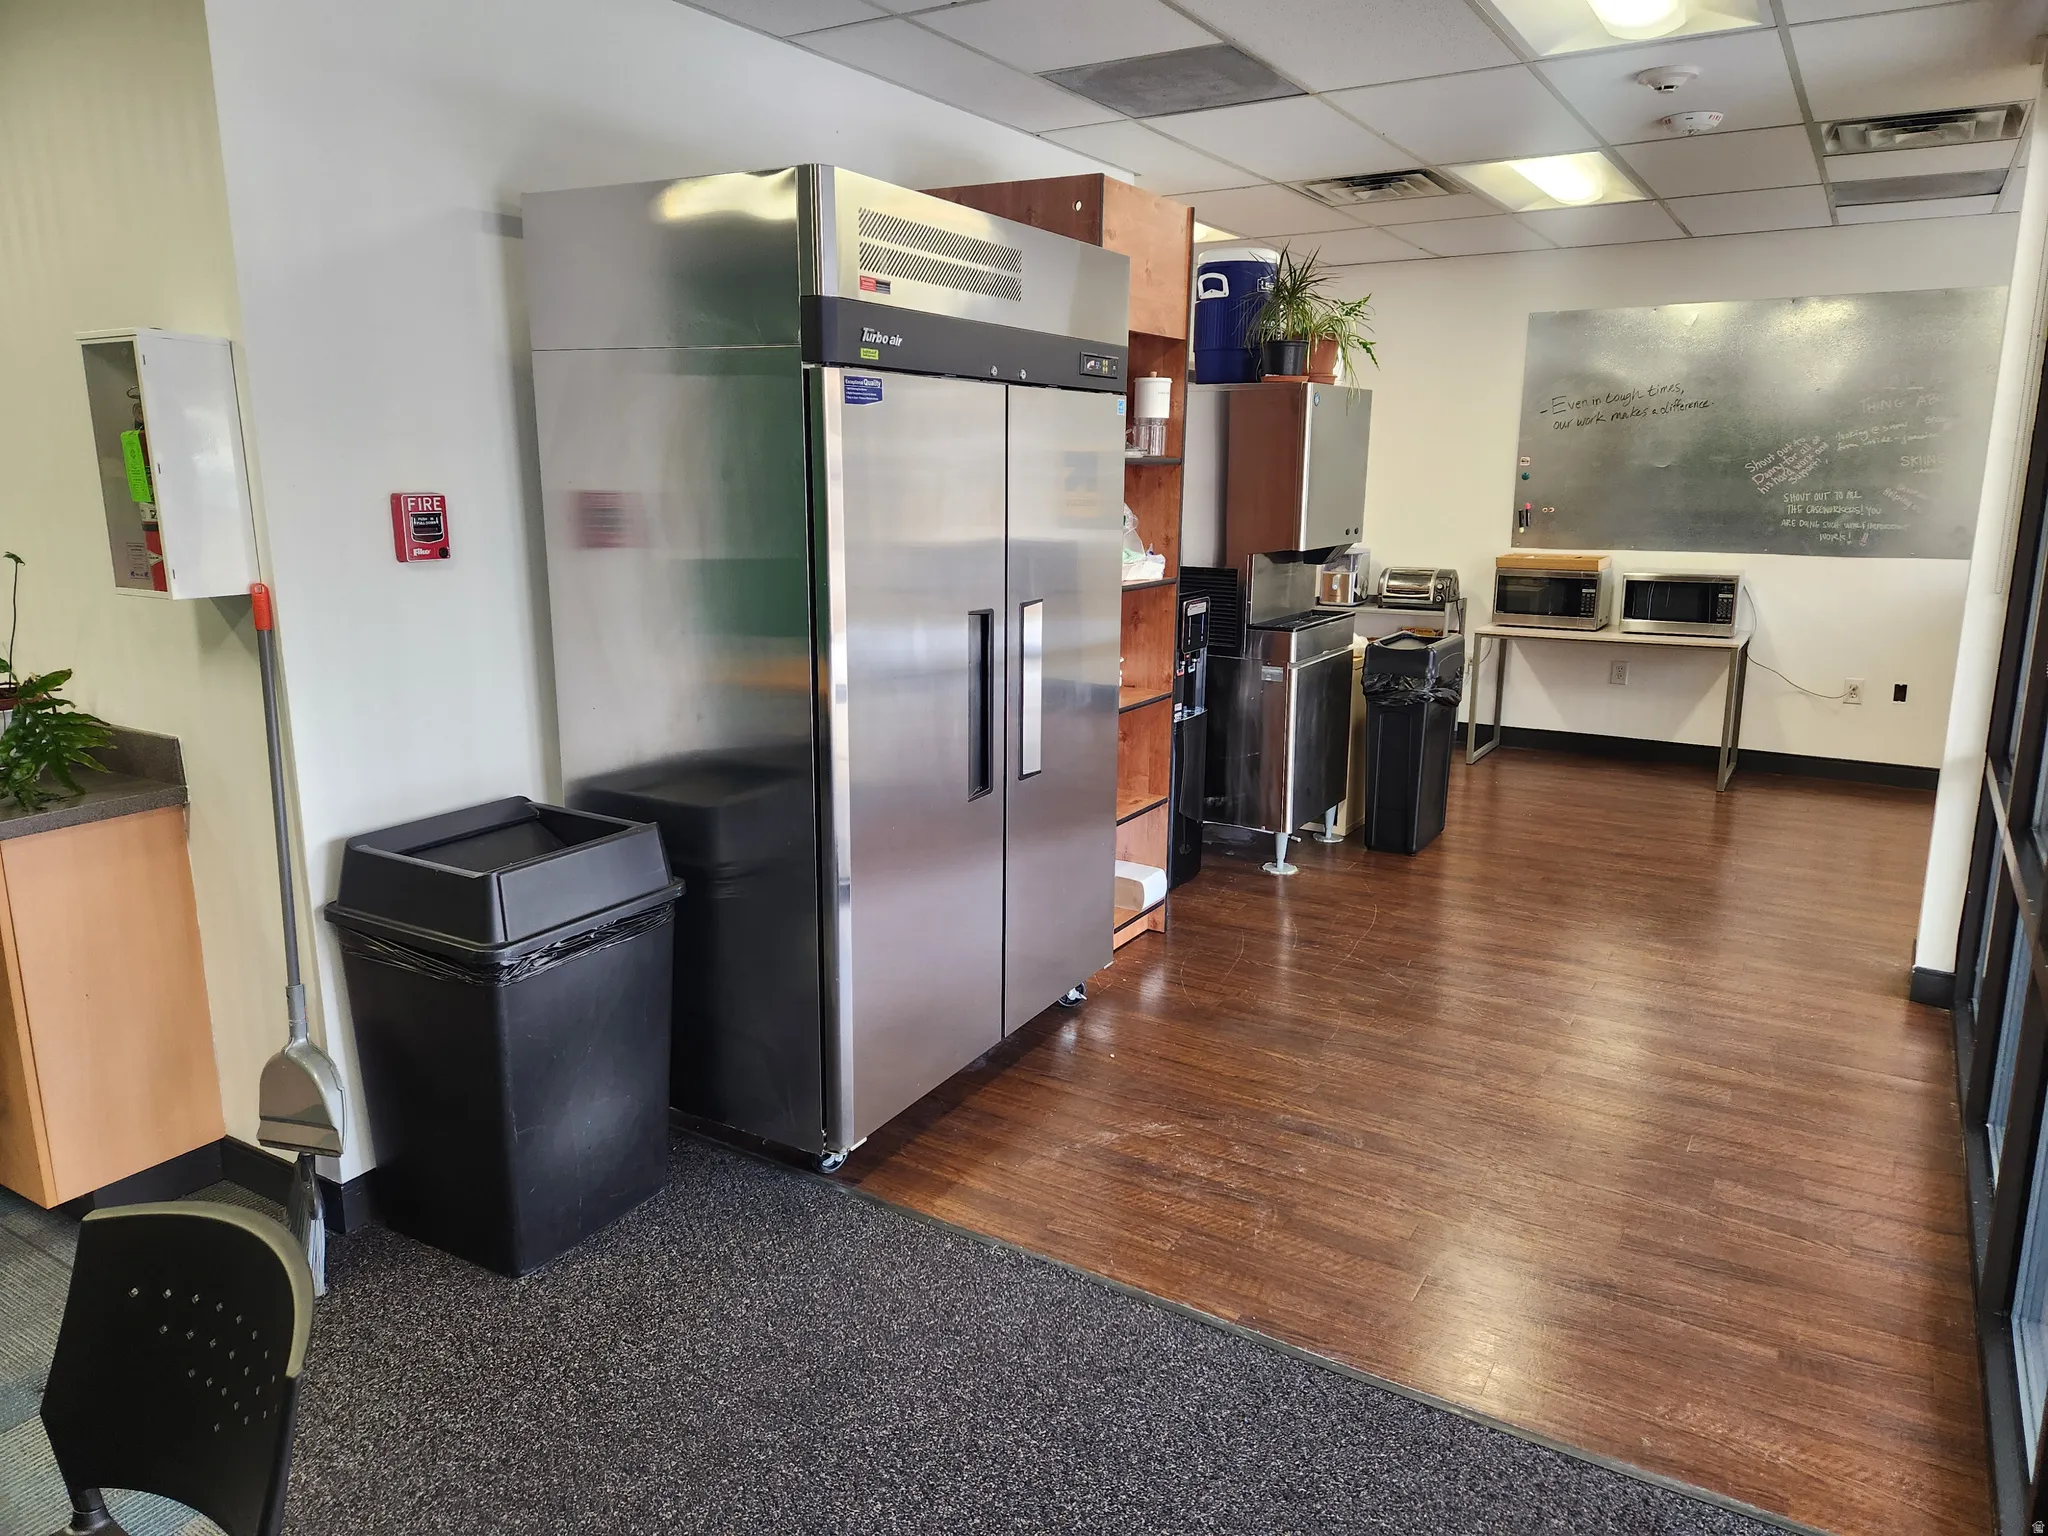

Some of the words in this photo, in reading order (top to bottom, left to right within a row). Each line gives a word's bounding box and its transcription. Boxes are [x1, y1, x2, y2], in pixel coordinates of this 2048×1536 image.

[862, 327, 888, 344] Turbo
[889, 335, 903, 346] air
[864, 379, 881, 388] Quality
[1592, 397, 1602, 406] in
[1605, 388, 1644, 408] tough
[1647, 382, 1685, 397] times,
[1552, 419, 1573, 430] our
[1576, 412, 1607, 427] work
[1611, 406, 1648, 421] makes
[1745, 453, 1775, 473] Shout
[1776, 443, 1792, 457] out
[1793, 437, 1806, 446] to
[1800, 443, 1812, 455] all
[1757, 481, 1774, 495] his
[1771, 466, 1795, 484] hard
[1793, 453, 1814, 471] work
[1815, 442, 1829, 455] and
[407, 497, 442, 511] FIRE
[1783, 492, 1809, 503] SHOUT
[1814, 491, 1831, 501] OUT
[1834, 491, 1844, 500] TO
[1846, 491, 1862, 499] ALL
[1787, 504, 1802, 514] THE
[1780, 519, 1796, 527] ARE
